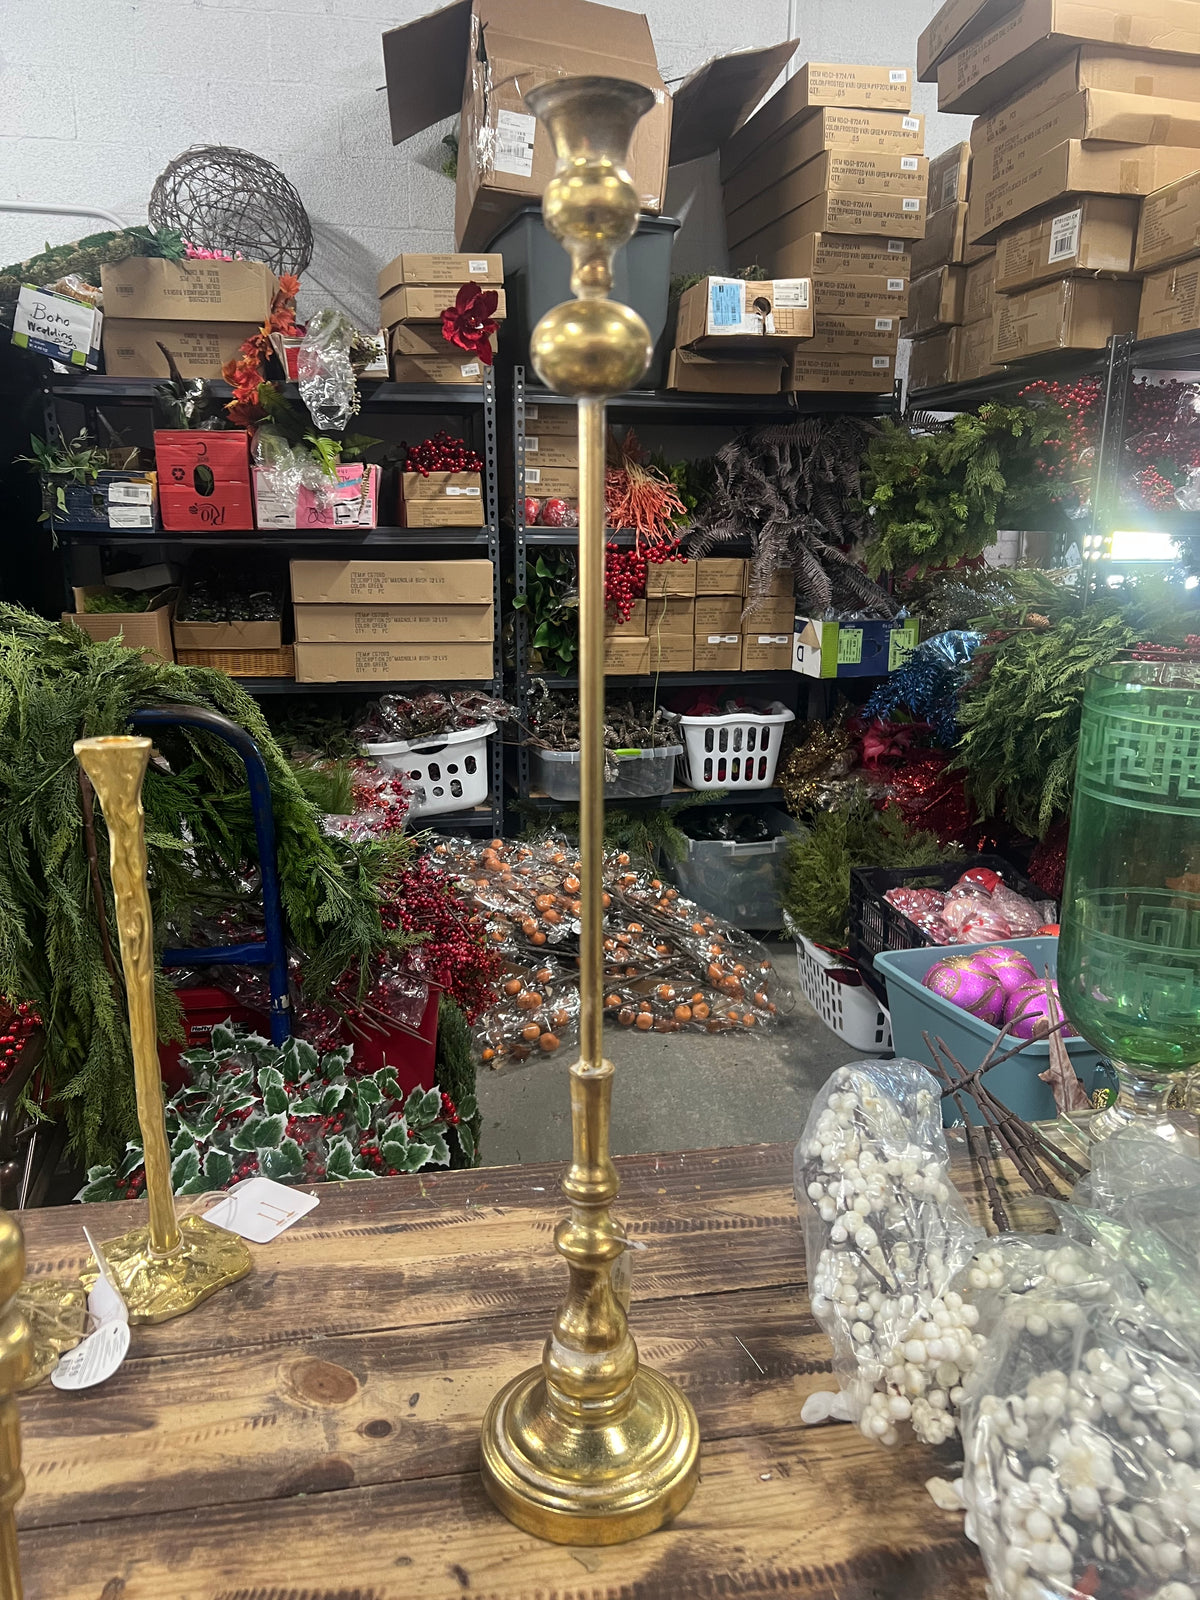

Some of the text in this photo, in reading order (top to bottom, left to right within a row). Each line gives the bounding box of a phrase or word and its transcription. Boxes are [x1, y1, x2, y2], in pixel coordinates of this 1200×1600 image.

[30, 302, 69, 326] Boho
[28, 320, 72, 342] Wedding
[196, 442, 207, 456] C
[199, 503, 225, 526] Rio
